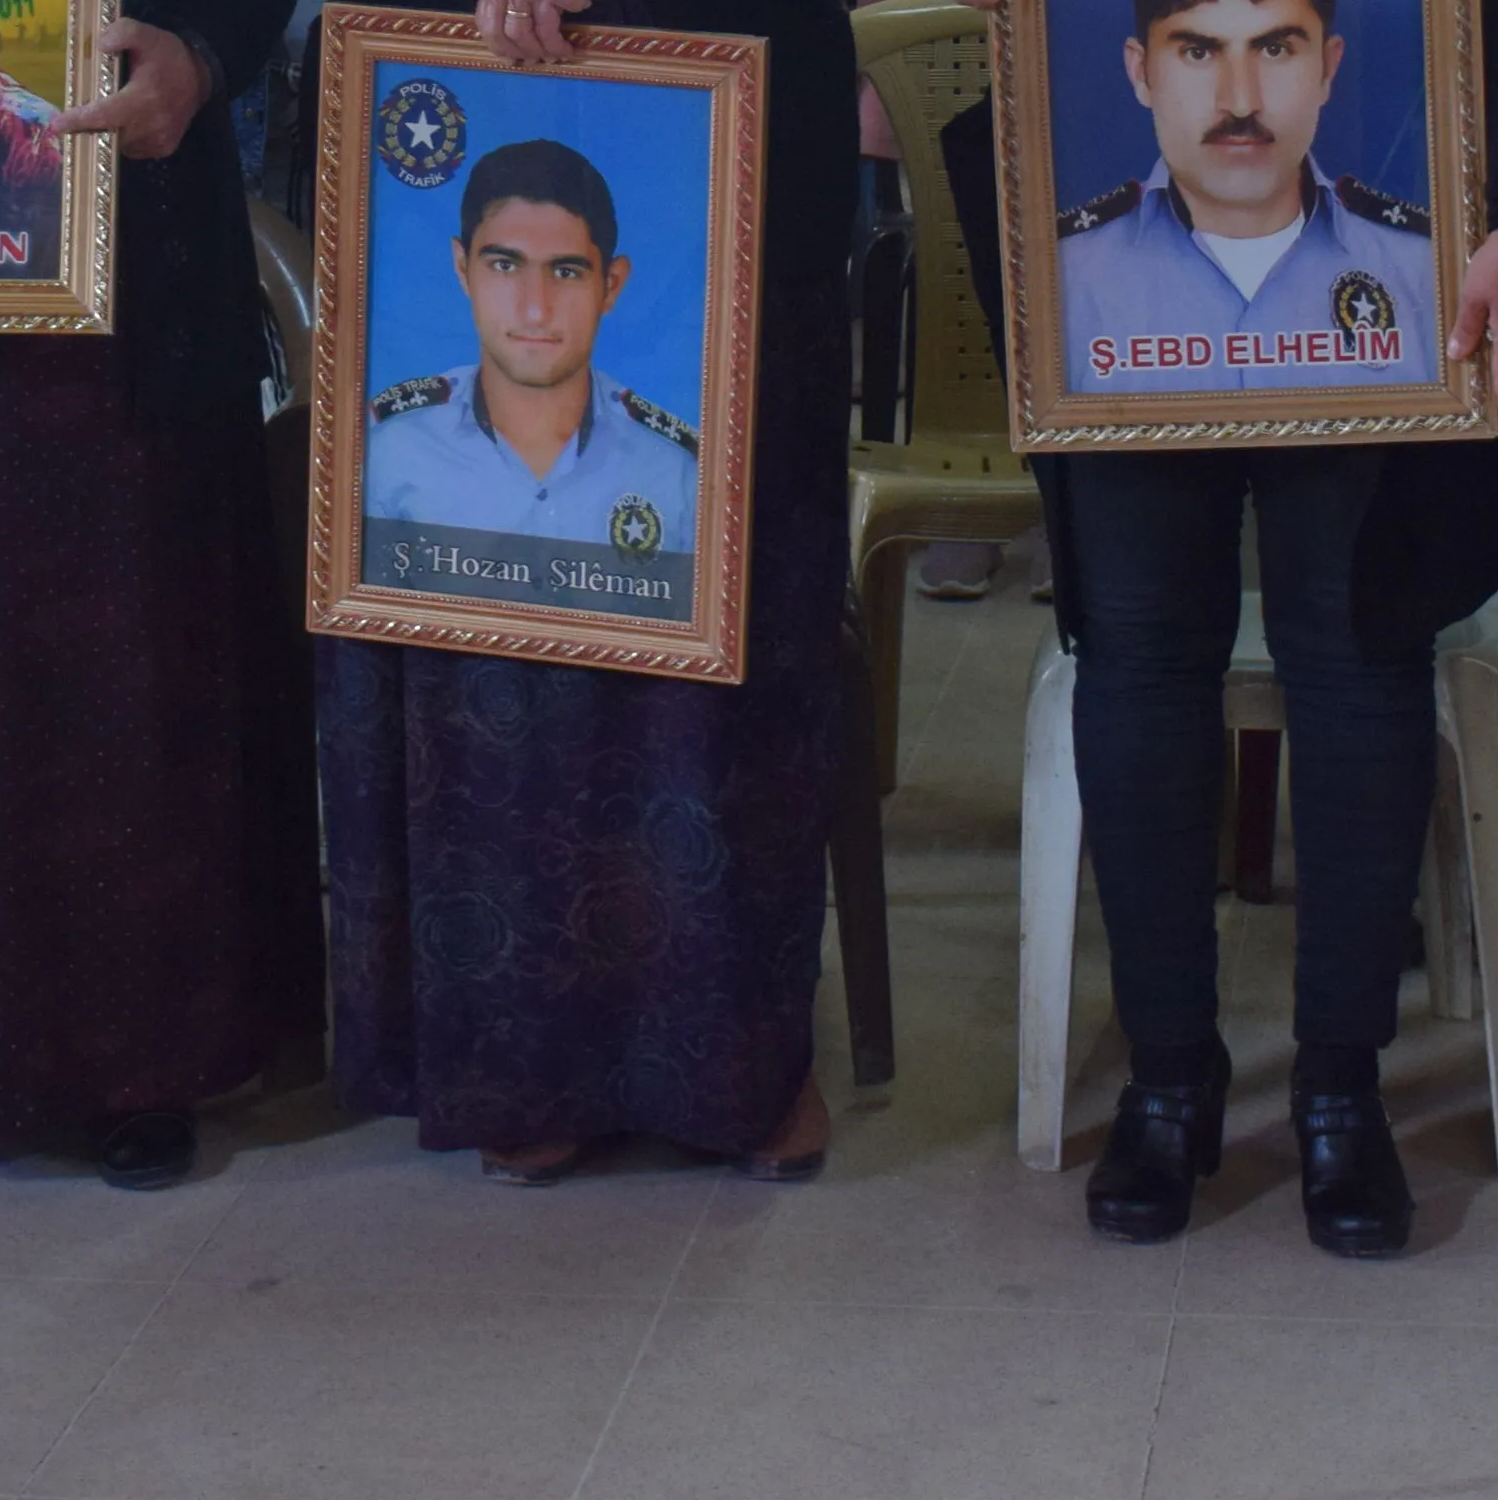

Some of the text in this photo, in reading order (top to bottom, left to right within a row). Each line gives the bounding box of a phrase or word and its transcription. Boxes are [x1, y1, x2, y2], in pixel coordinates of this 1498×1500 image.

[1090, 321, 1402, 377] Ş.EBD ELHELÎM
[432, 545, 532, 583] Hozan
